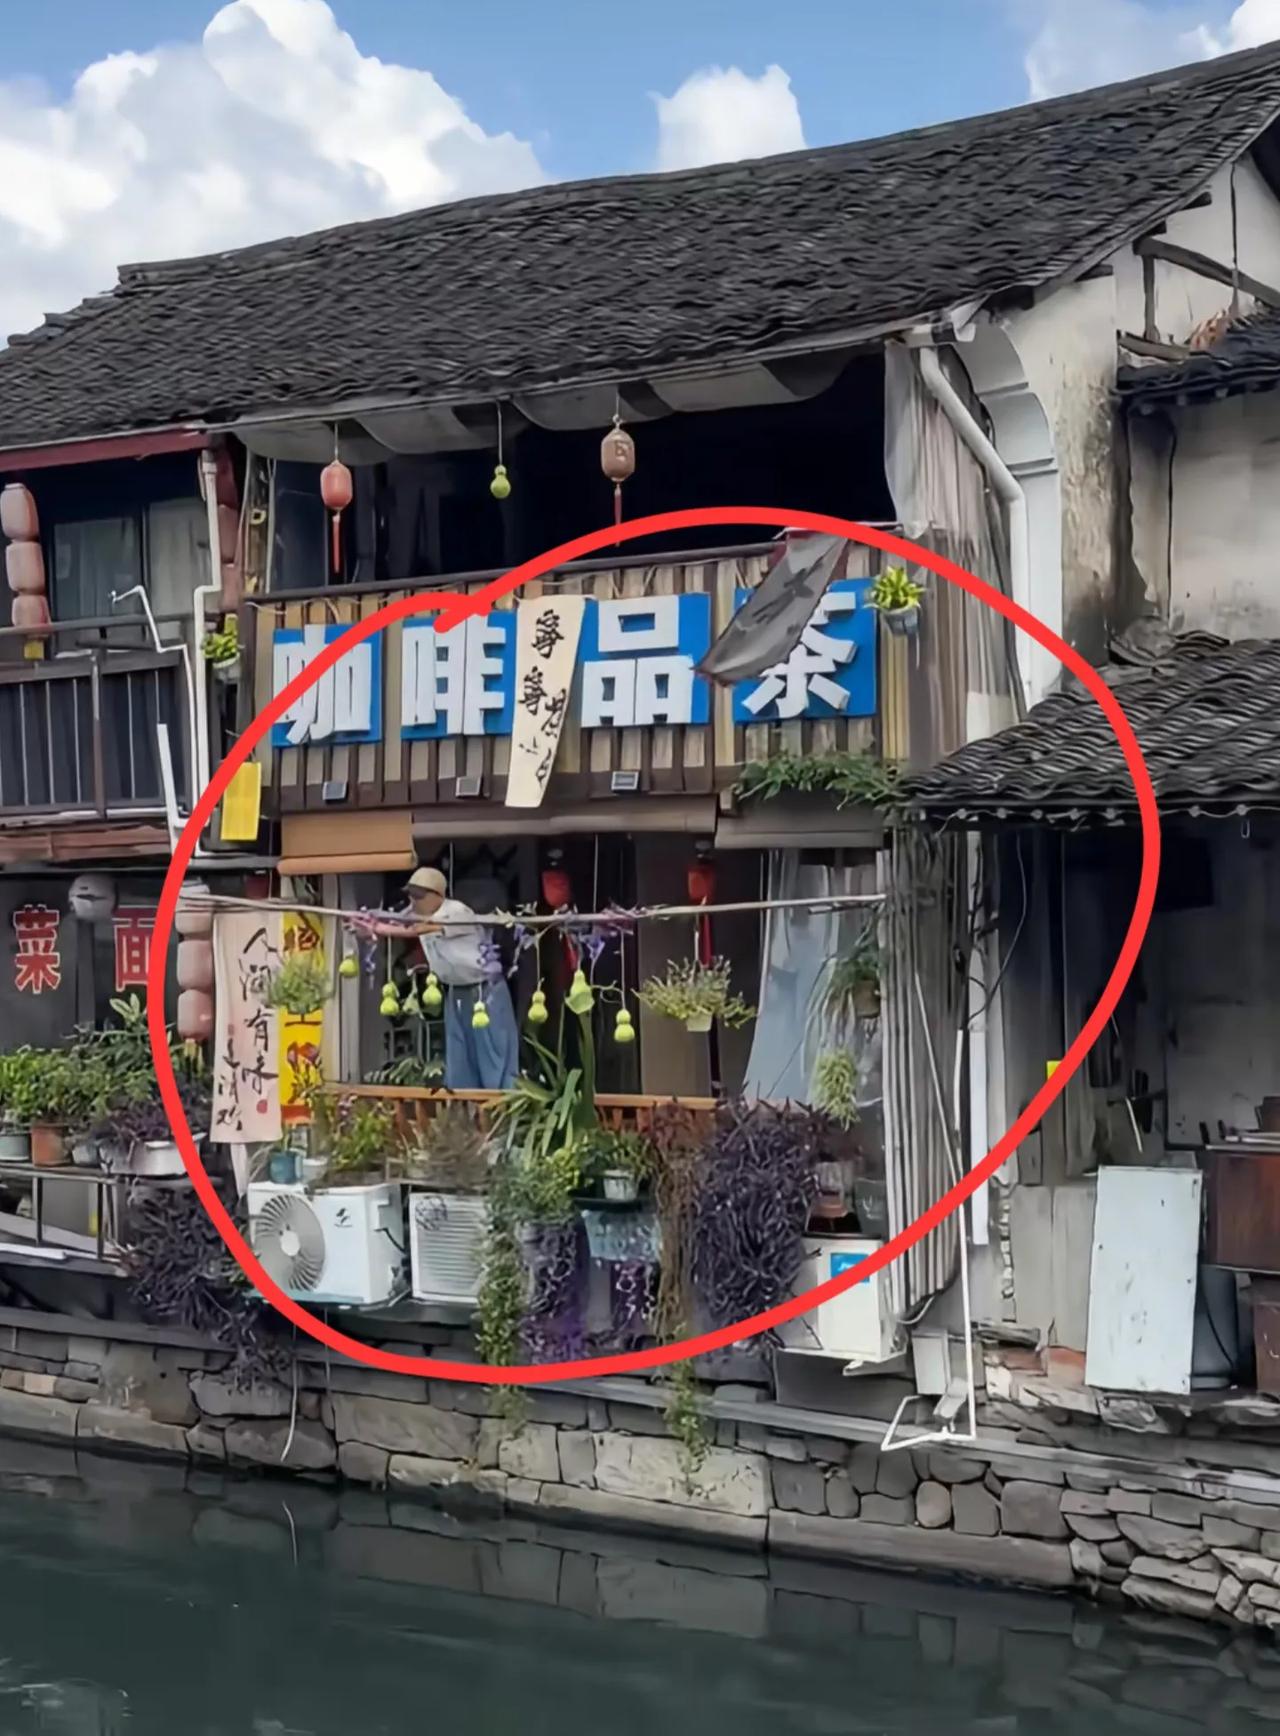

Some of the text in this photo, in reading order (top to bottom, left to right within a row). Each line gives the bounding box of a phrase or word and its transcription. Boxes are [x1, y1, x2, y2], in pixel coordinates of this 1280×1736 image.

[273, 592, 858, 744] 咖啡品茶
[13, 904, 160, 994] 菜 面
